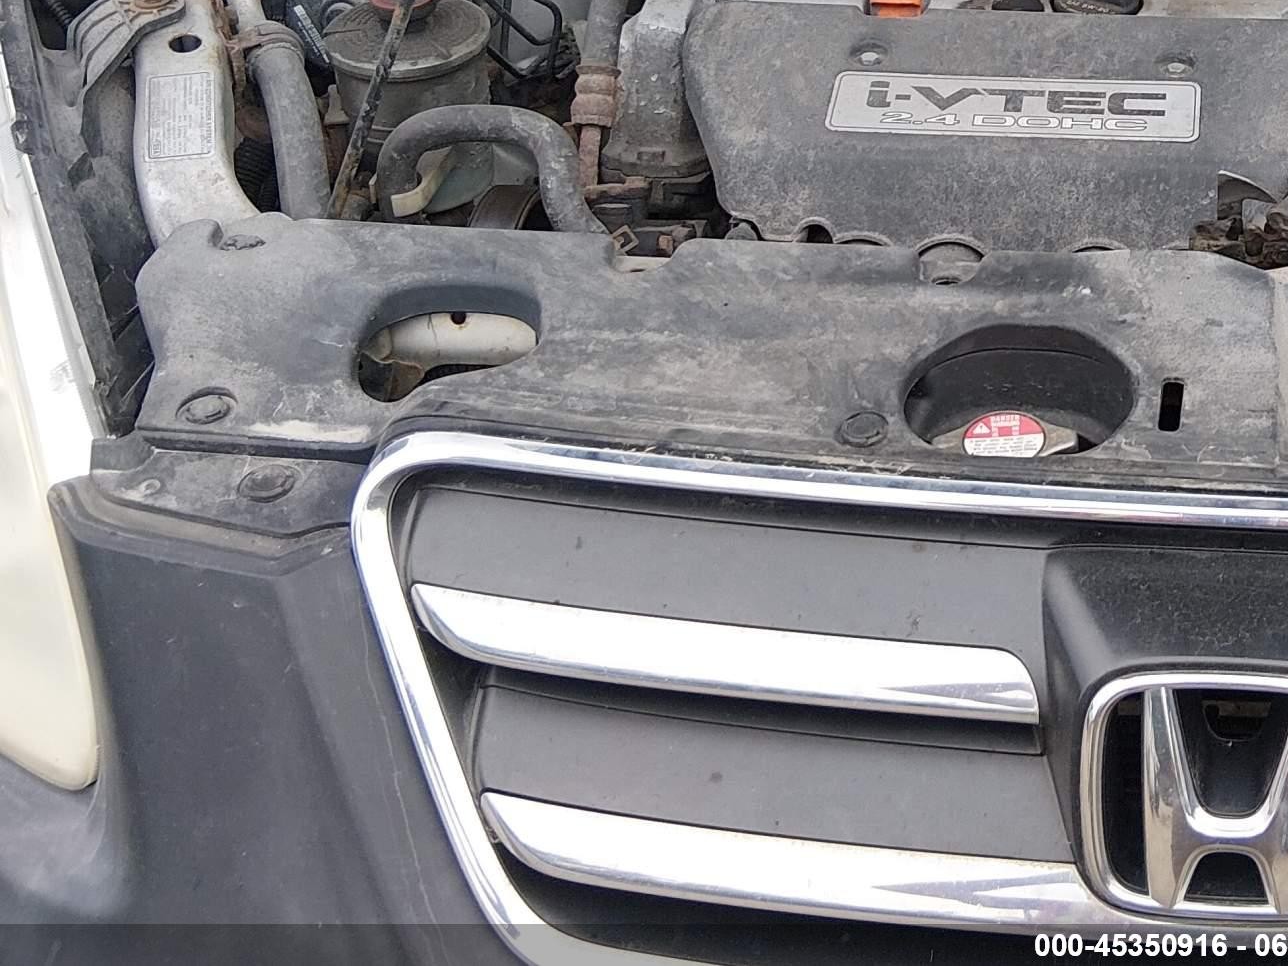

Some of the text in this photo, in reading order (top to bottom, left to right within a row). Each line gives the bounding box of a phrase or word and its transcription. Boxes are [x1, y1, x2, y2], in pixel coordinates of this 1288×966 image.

[866, 81, 1167, 117] i-VTEC
[880, 111, 1148, 132] 2.4 DOHC
